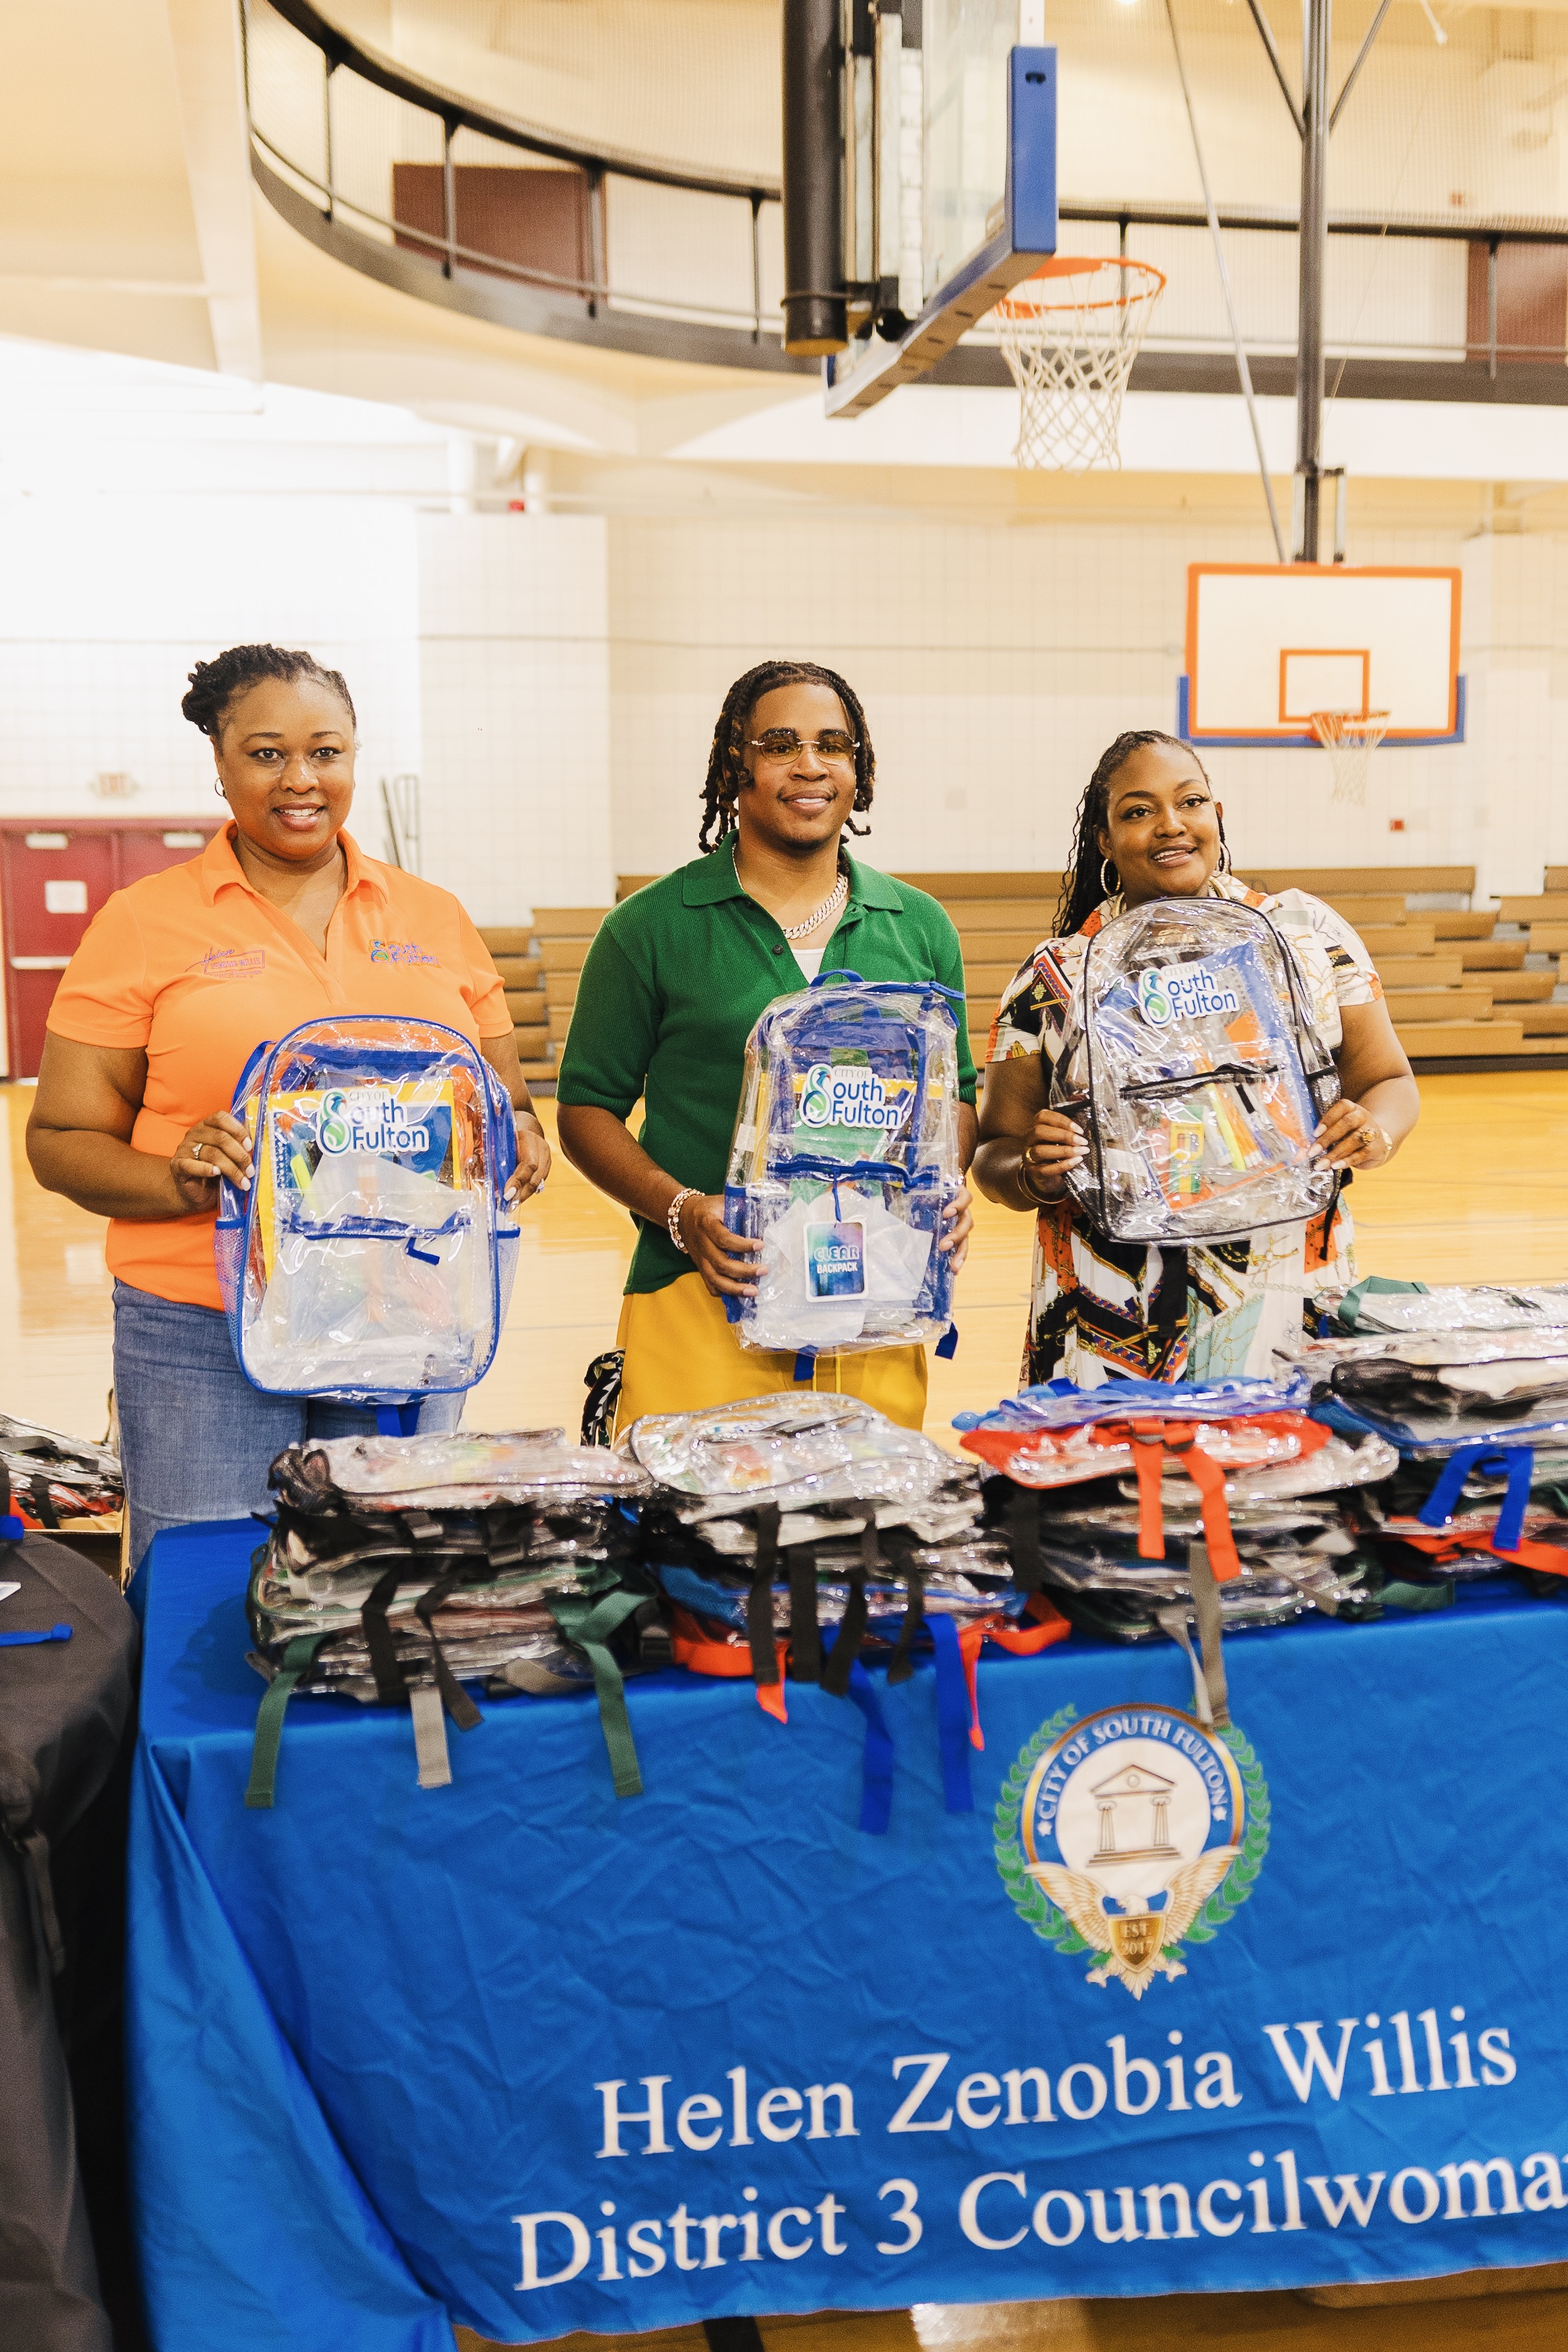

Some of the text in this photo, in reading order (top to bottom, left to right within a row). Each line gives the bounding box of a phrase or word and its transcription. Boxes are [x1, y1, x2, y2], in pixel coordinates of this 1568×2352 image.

[1172, 992, 1236, 1018] Fulton
[834, 1069, 870, 1079] CITY OF
[374, 1091, 388, 1101] OF
[832, 1100, 898, 1126] Fulton
[352, 1123, 426, 1150] Fulton
[814, 1245, 860, 1262] CLEAR
[817, 1261, 858, 1274] BACKPACK
[1037, 1716, 1228, 1820] CITY OF SOUTH FULTON
[594, 2005, 1517, 2159] Helen Zenobia Willis
[511, 2149, 1568, 2291] District 3 Councilwoma
